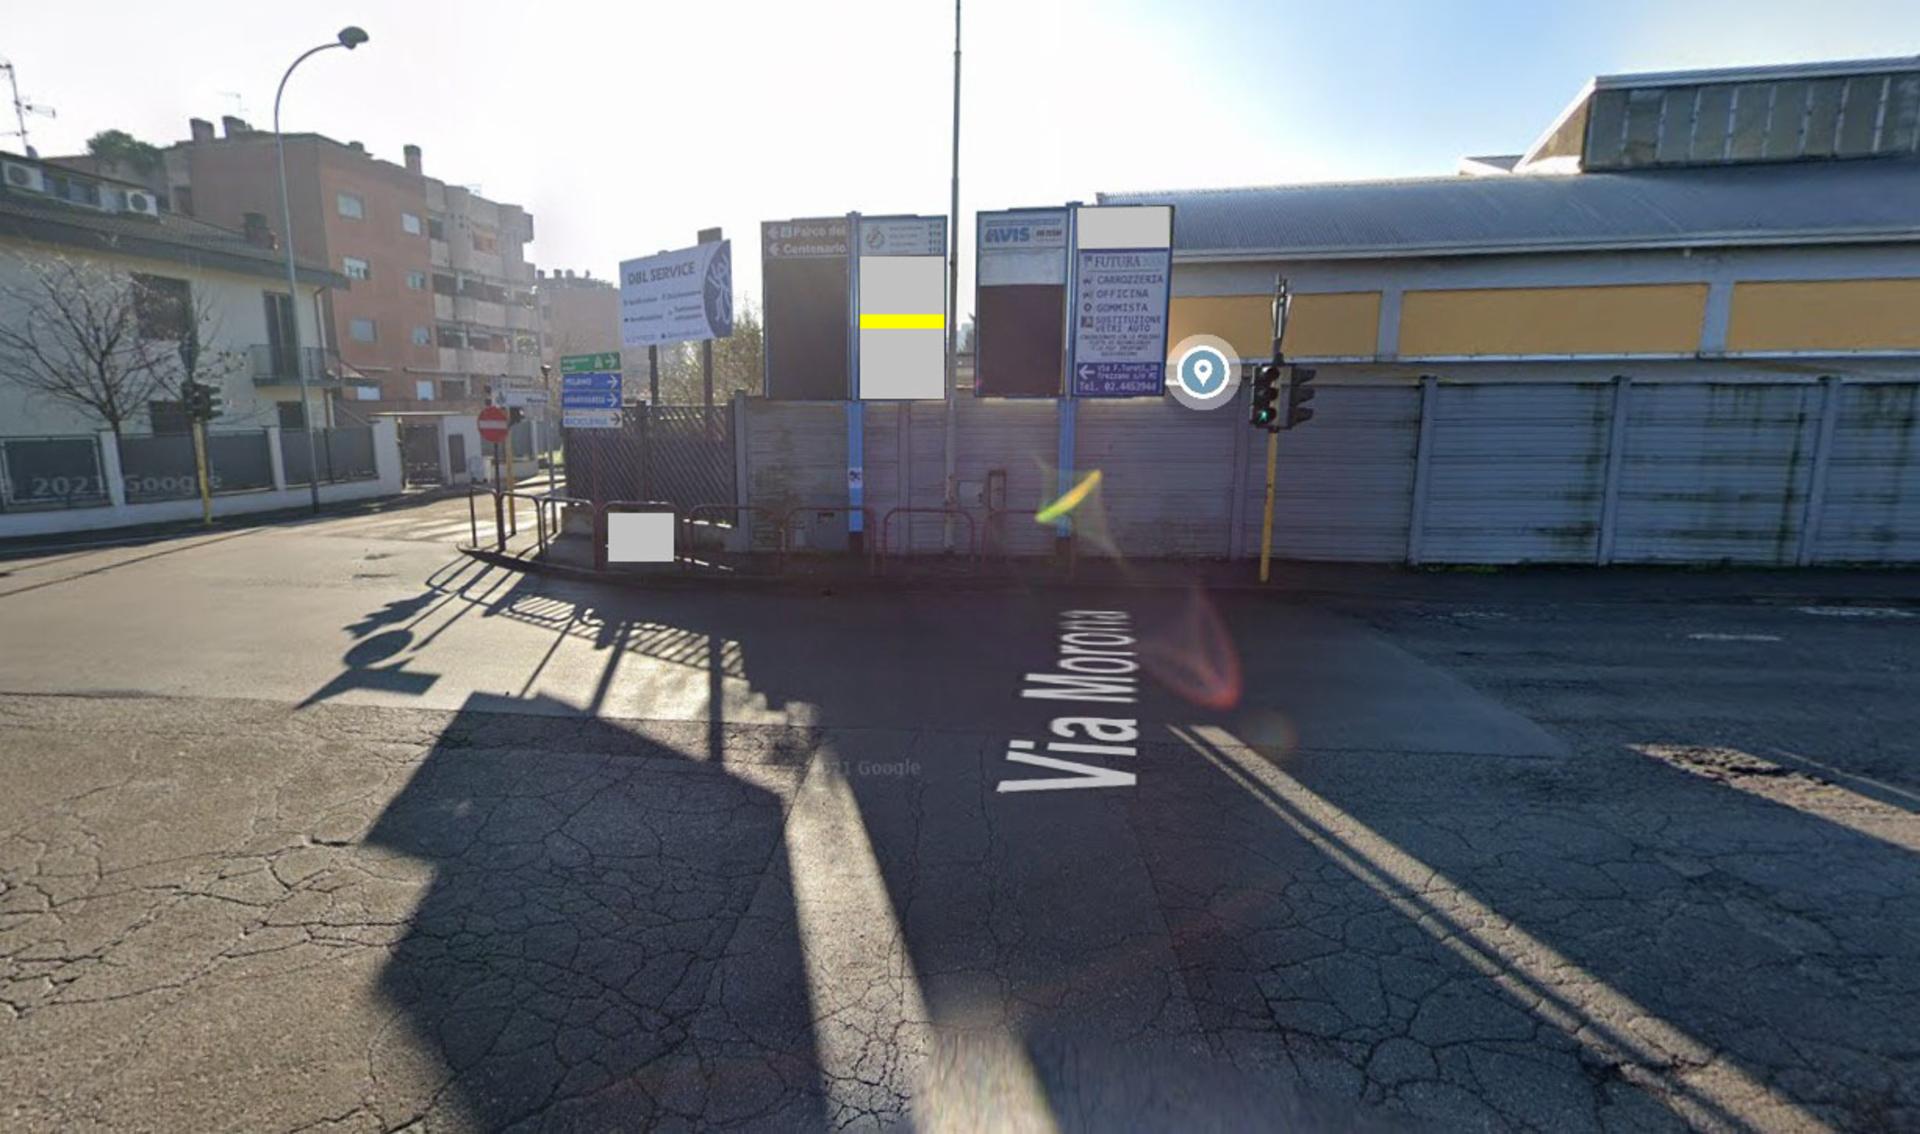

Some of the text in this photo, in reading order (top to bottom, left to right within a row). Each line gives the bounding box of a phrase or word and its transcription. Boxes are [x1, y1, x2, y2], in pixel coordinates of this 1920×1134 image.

[985, 227, 1030, 243] AVIS
[1095, 255, 1141, 268] FUTURA
[651, 260, 695, 281] SERVICE
[1097, 274, 1164, 285] CARROZZERIA
[1096, 289, 1149, 299] OFFICINA
[1096, 303, 1148, 313] GOMMISTA
[1128, 324, 1151, 333] AUTO
